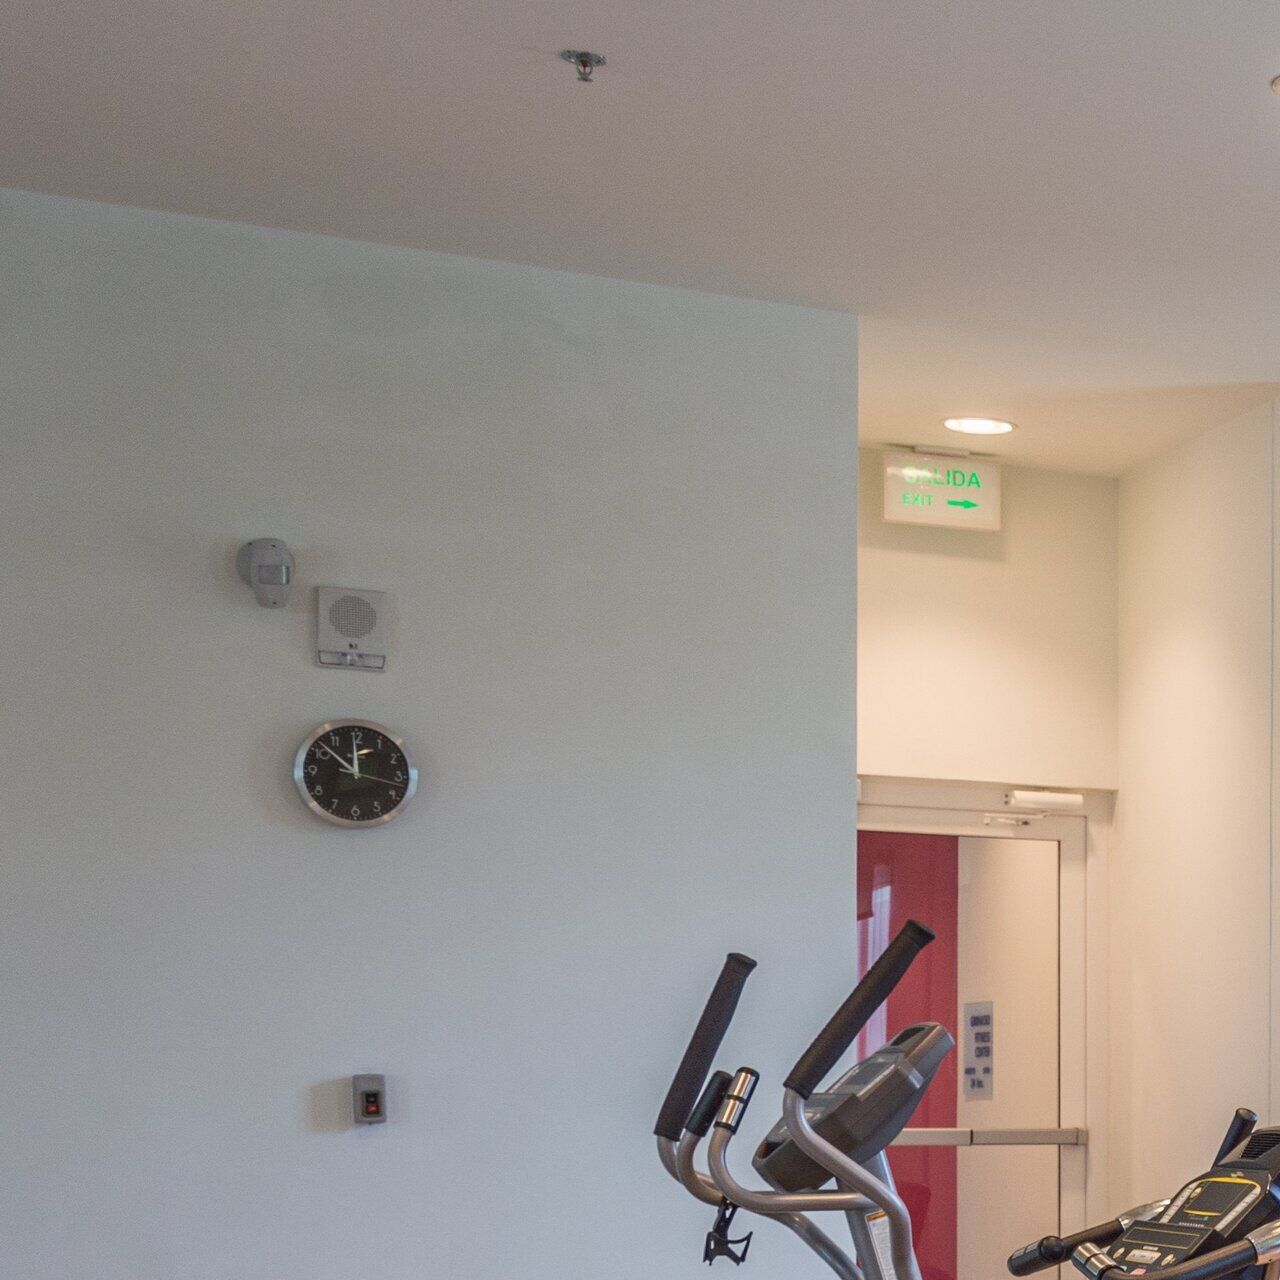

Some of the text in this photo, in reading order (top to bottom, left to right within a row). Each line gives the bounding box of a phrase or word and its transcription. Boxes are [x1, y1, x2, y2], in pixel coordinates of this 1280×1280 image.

[902, 492, 934, 506] EXIT
[330, 736, 340, 747] 11
[377, 739, 382, 750] 1
[315, 748, 331, 760] 10
[390, 753, 398, 764] 2
[308, 765, 318, 776] 9
[394, 771, 403, 782] 3
[314, 785, 323, 796] 8
[331, 799, 339, 809] 7
[373, 801, 381, 812] 5
[351, 805, 361, 817] 6
